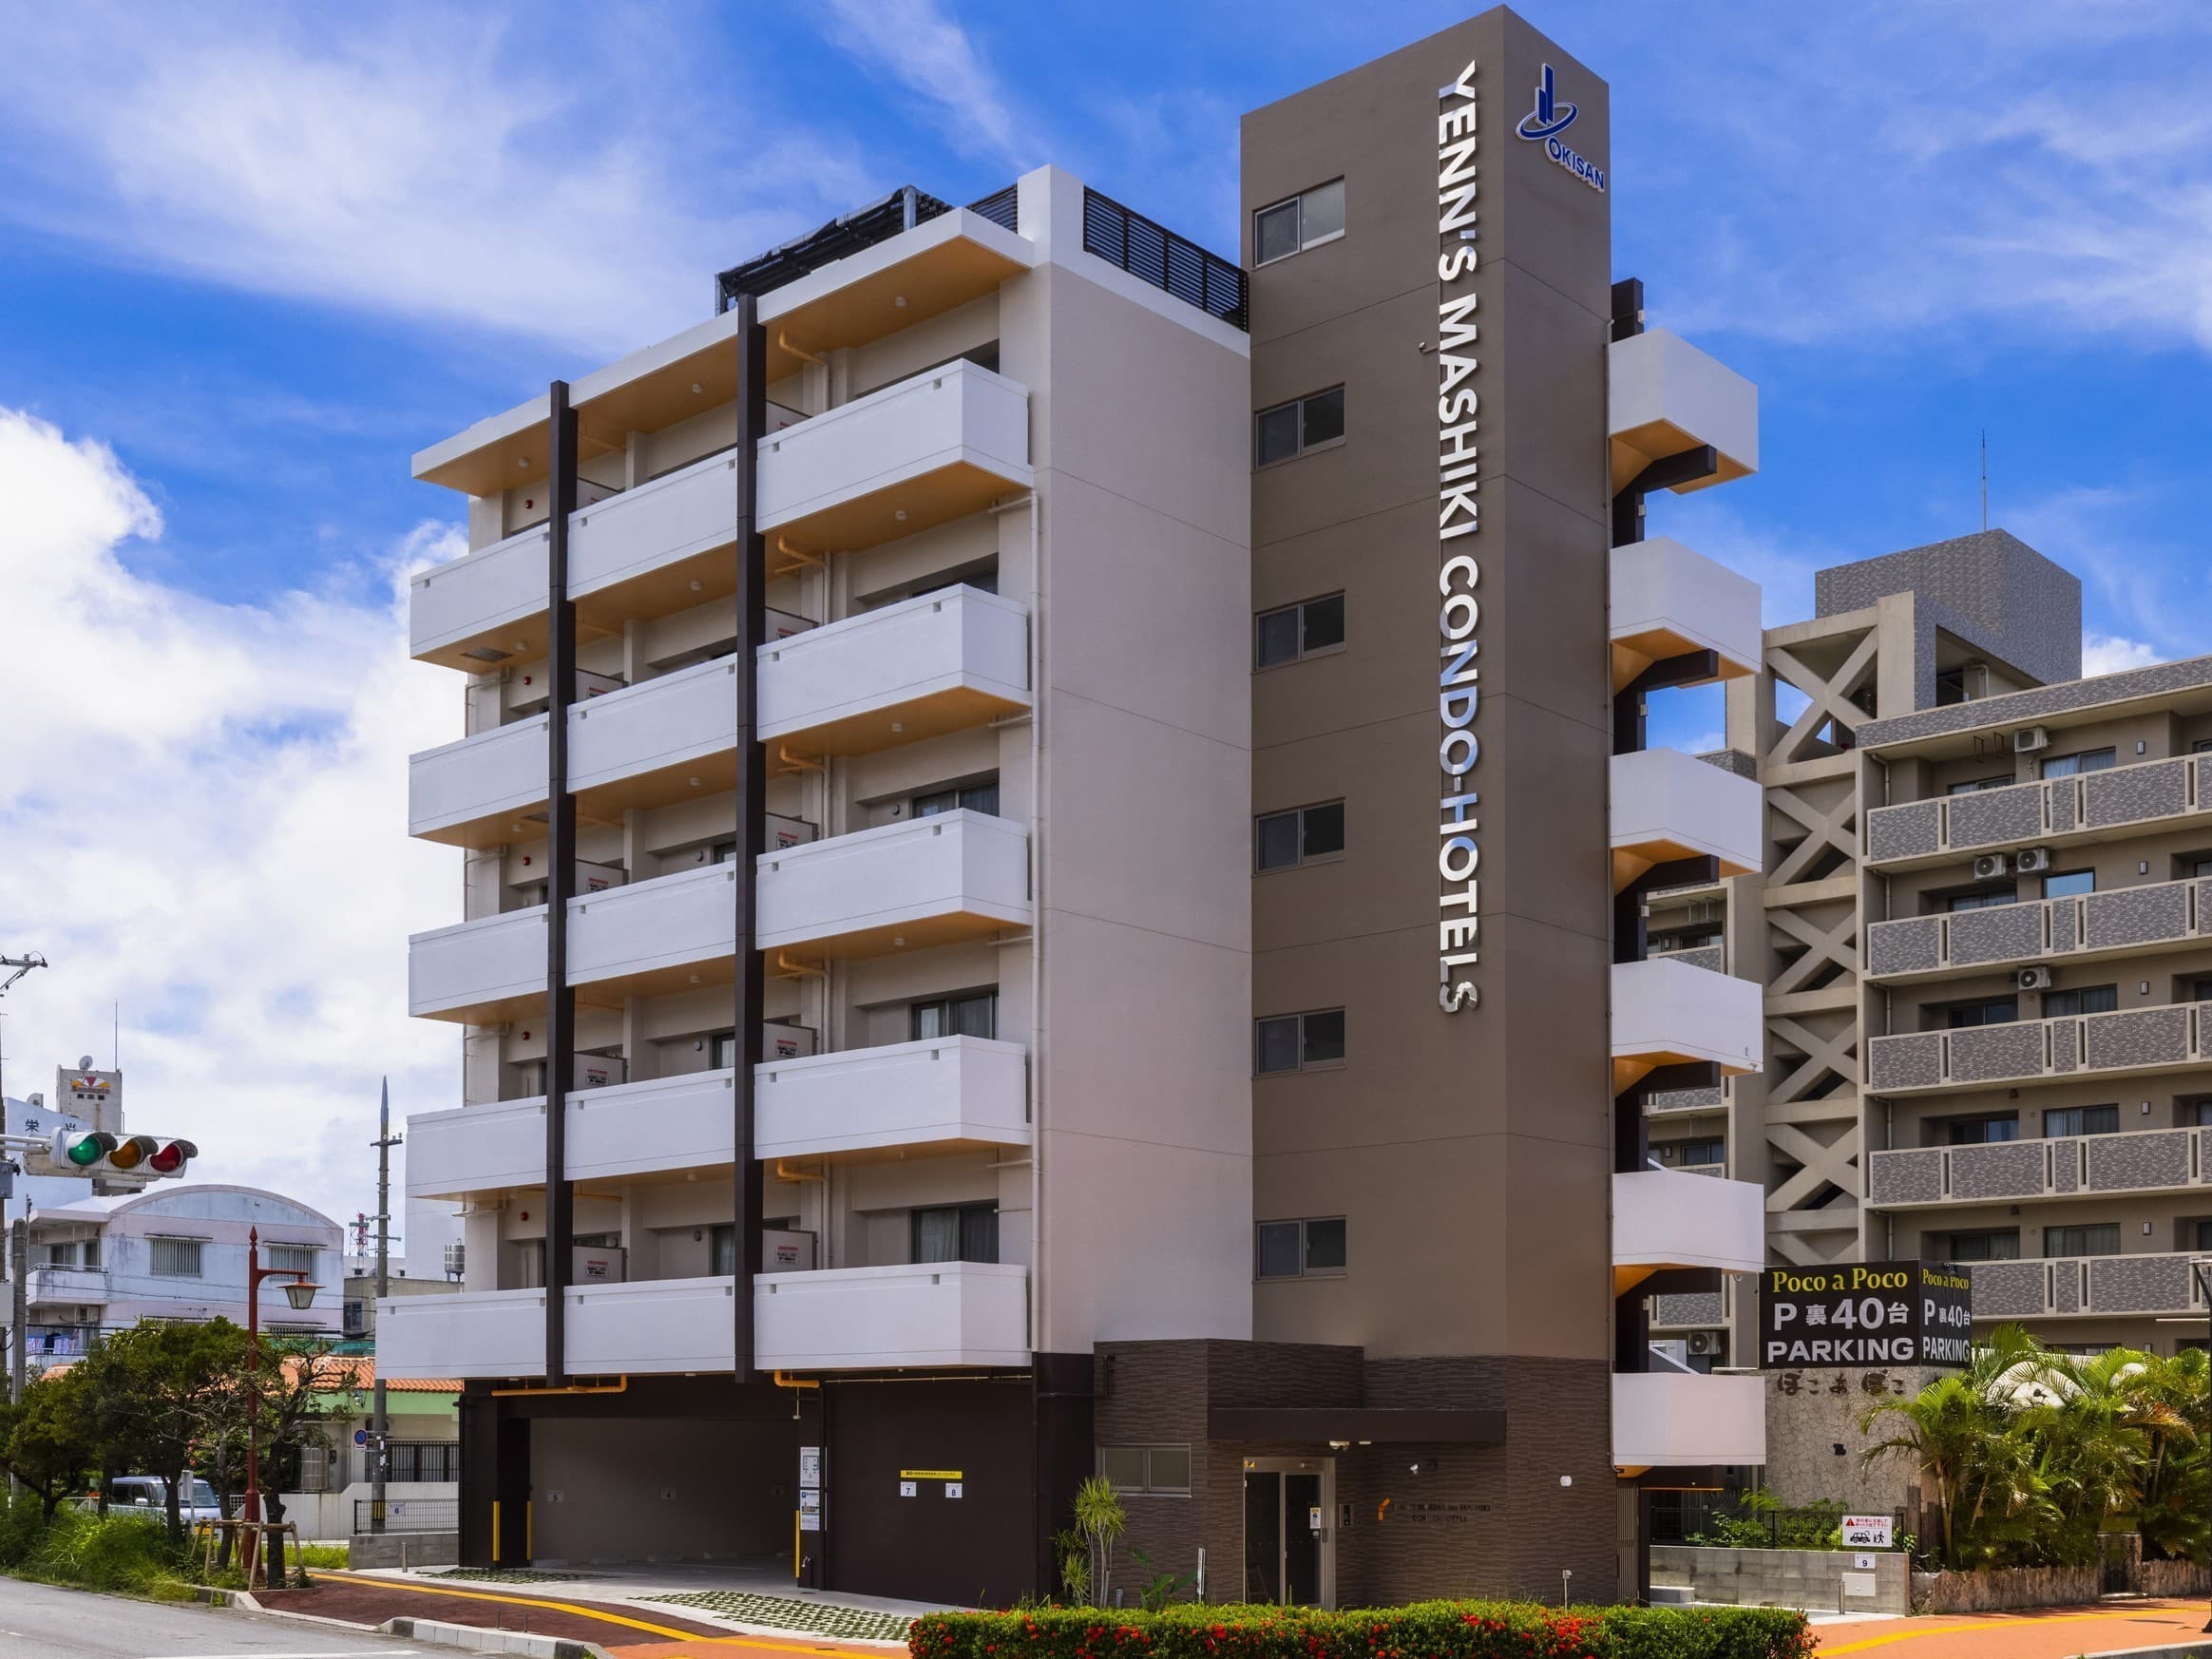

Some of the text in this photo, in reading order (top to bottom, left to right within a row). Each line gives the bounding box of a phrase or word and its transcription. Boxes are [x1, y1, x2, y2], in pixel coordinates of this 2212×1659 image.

[1546, 136, 1605, 192] OKISAN
[1439, 59, 1480, 1014] YENN'S MASHIKI CONDO-HOTELS
[1772, 1268, 1908, 1293] Poco a Poco
[1922, 1268, 1942, 1287] Poco
[1774, 1303, 1798, 1330] P
[1924, 1299, 1936, 1325] P
[1767, 1337, 1915, 1363] PARKING
[1922, 1336, 1970, 1363] PARKING
